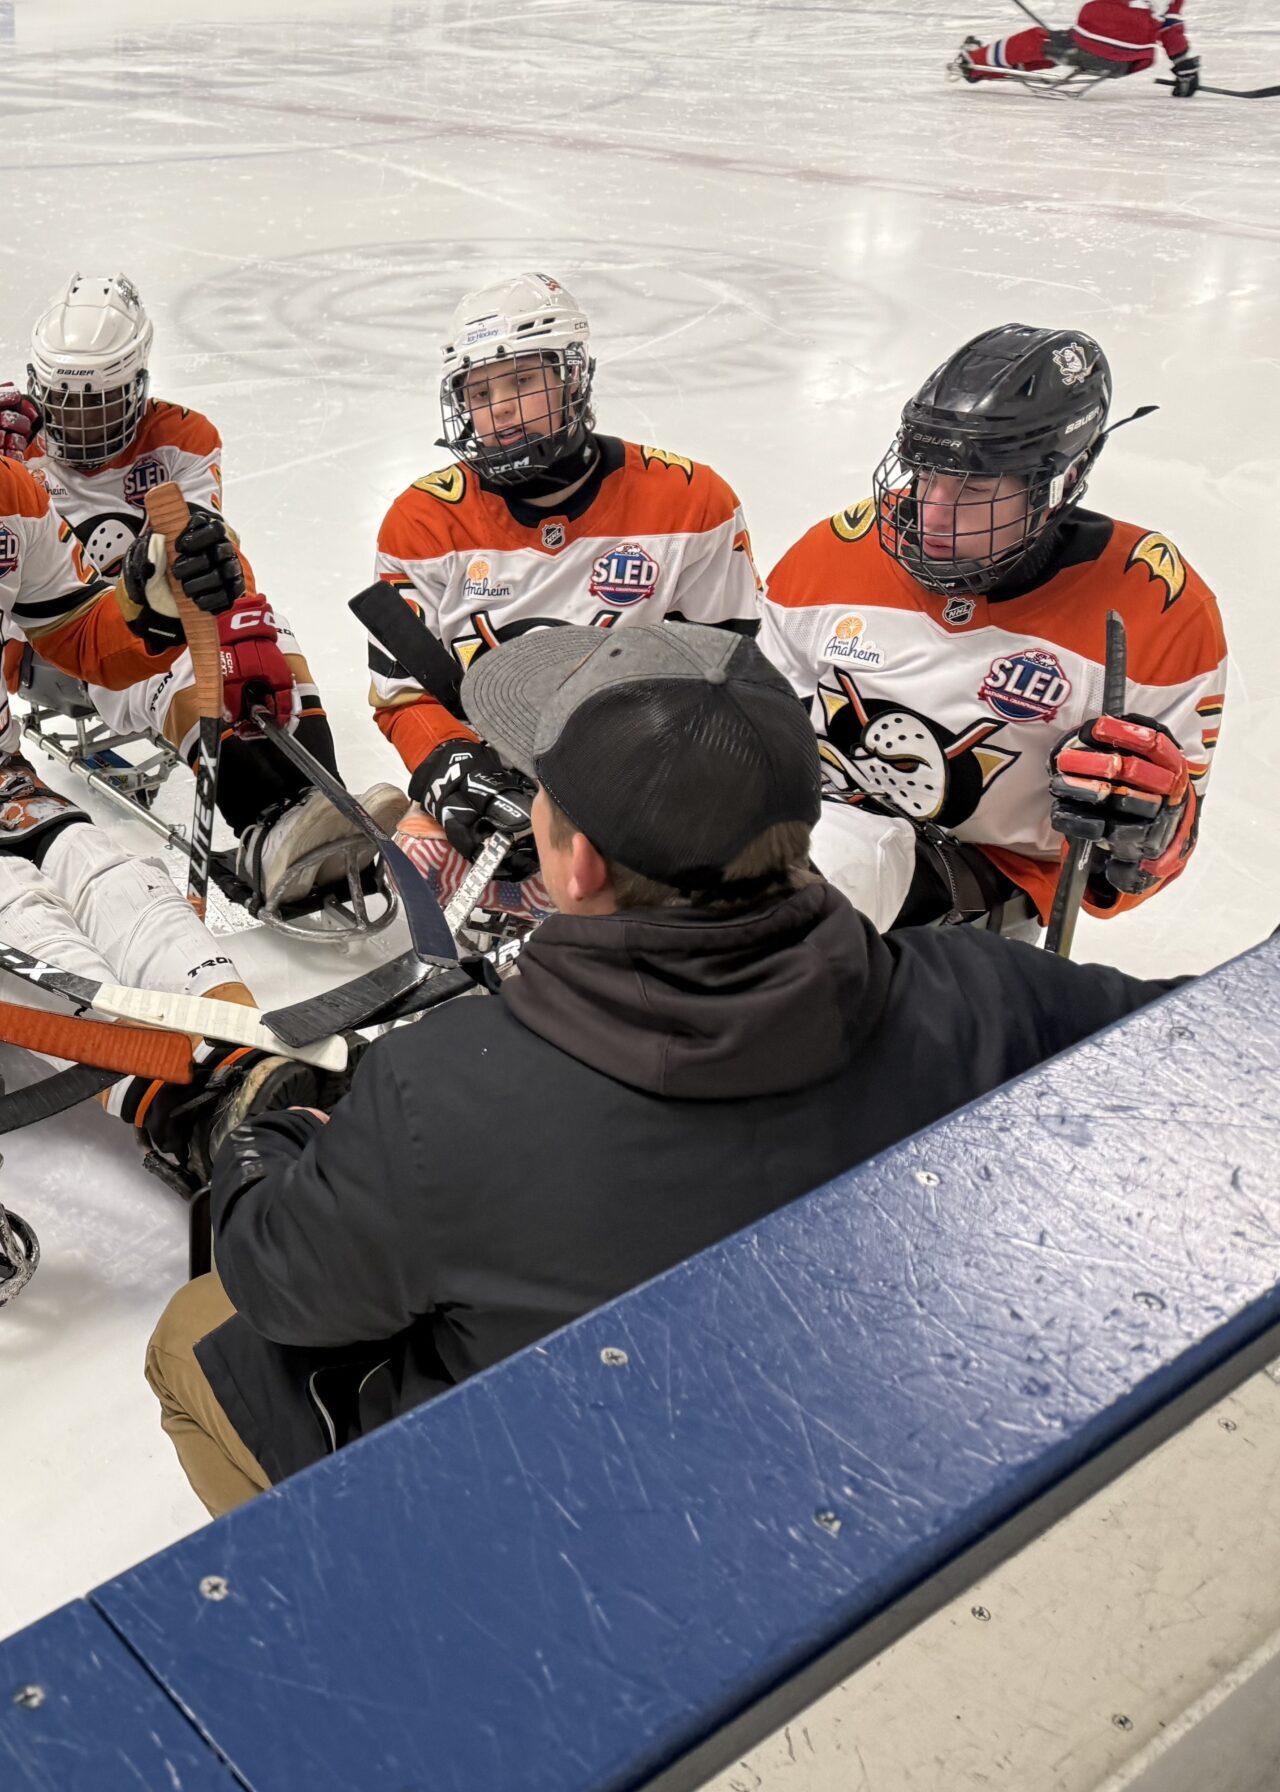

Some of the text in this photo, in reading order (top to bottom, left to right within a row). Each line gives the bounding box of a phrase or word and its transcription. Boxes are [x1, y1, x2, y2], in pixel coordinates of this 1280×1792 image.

[56, 368, 95, 376] BAUER
[1064, 405, 1101, 435] BAUER
[913, 433, 963, 449] BAUER
[592, 558, 658, 586] SLED
[463, 577, 511, 597] Anaheim
[949, 606, 969, 618] NHL
[823, 635, 880, 664] Anaheim
[985, 658, 1071, 708] SLED
[191, 738, 218, 881] LITE-X
[493, 800, 522, 819] CCM
